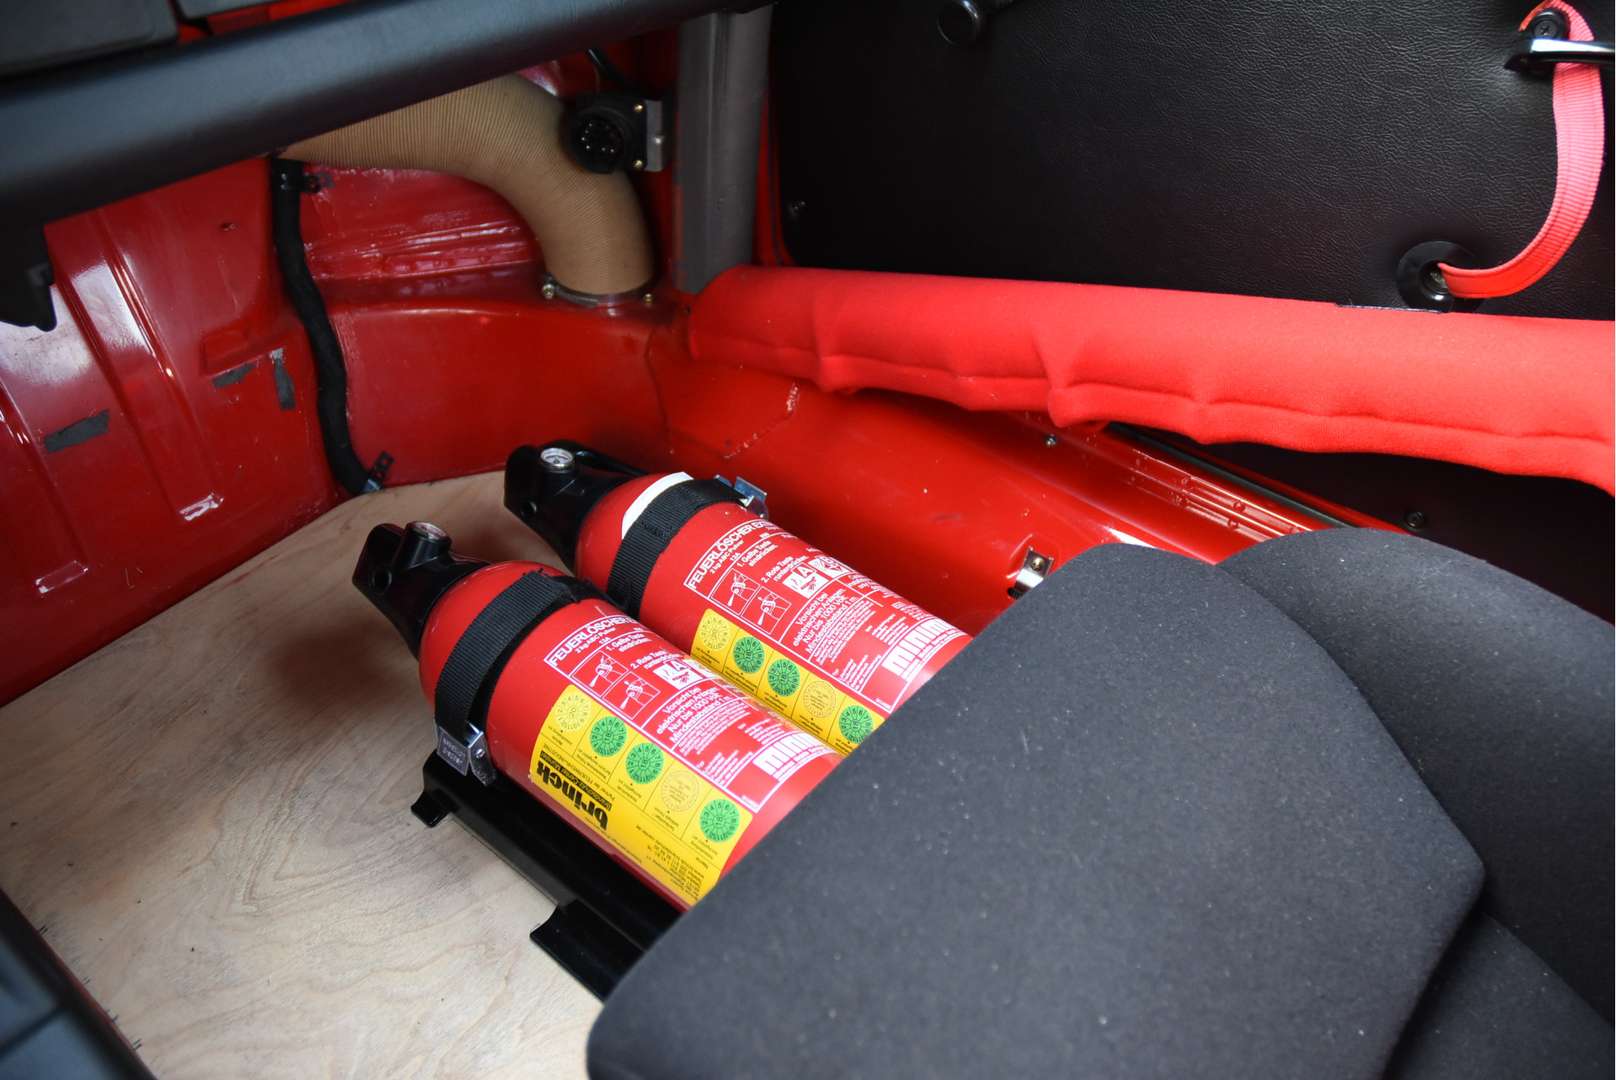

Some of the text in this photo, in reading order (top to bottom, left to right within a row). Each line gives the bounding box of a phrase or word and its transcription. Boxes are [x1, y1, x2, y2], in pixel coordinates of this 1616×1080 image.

[797, 567, 813, 577] A
[792, 606, 825, 646] elektrischen
[796, 600, 819, 625] Vorsicht
[802, 629, 815, 643] Nur
[812, 619, 824, 631] bis
[821, 604, 837, 619] 1000
[663, 692, 691, 713] Vorsicht
[667, 718, 684, 733] Nur
[680, 708, 693, 721] bis
[691, 696, 709, 712] 1000
[534, 760, 608, 830] brinck
